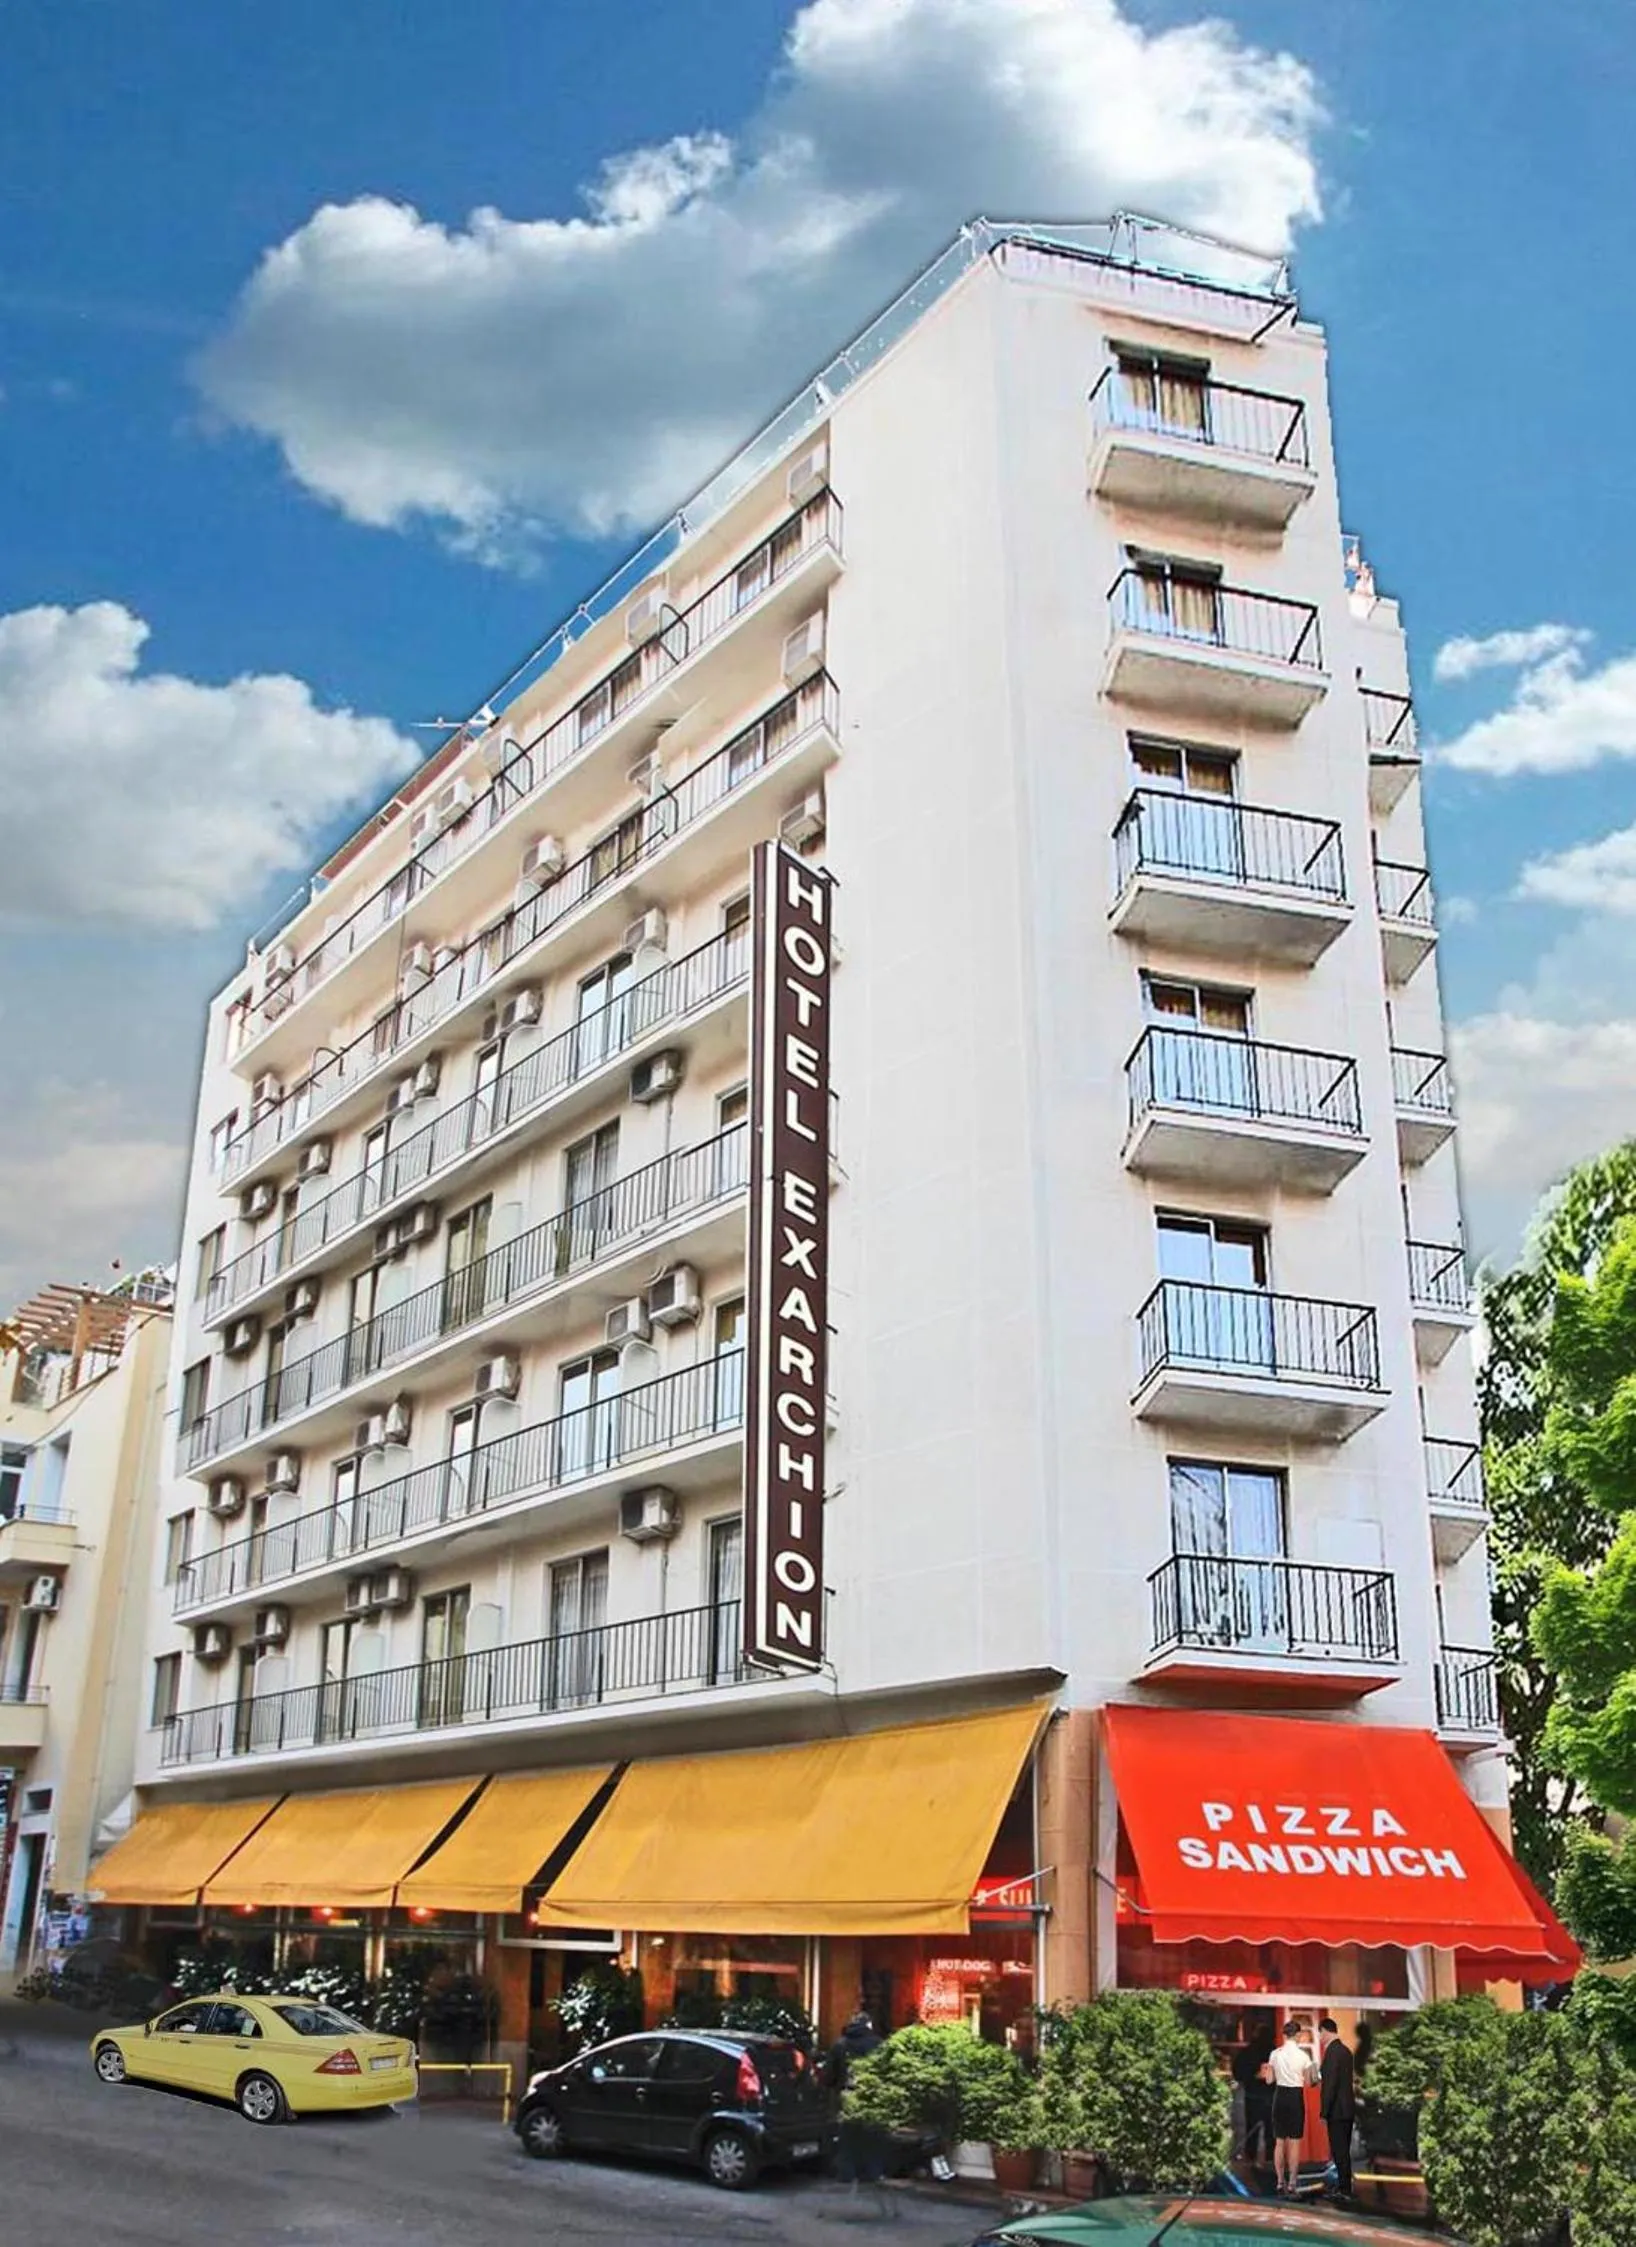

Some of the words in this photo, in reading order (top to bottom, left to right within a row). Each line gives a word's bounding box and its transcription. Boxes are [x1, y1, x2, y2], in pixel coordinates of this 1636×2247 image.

[782, 866, 826, 1142] HOTEL
[774, 1169, 819, 1648] EXARCHION
[1201, 1802, 1407, 1836] PIZZA
[1177, 1838, 1467, 1879] SANDWICH
[1187, 1974, 1247, 1988] PIZZA
